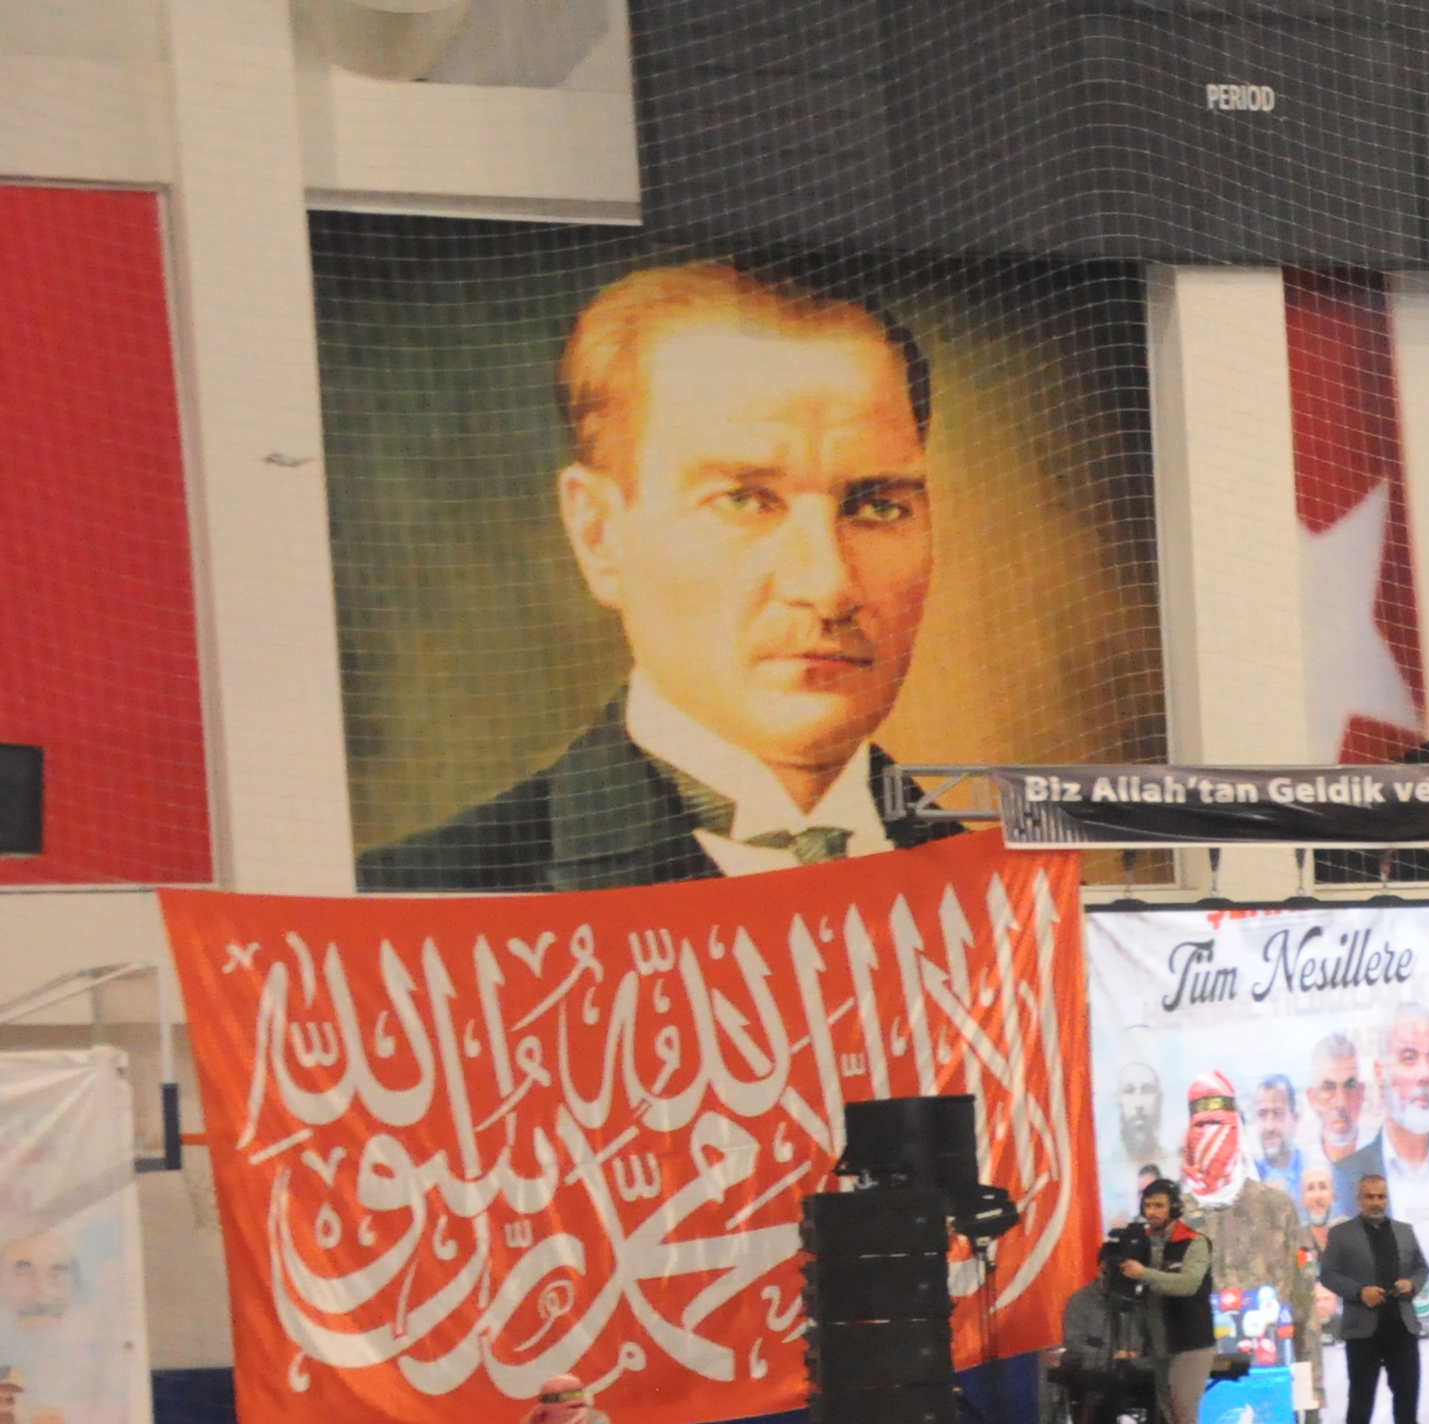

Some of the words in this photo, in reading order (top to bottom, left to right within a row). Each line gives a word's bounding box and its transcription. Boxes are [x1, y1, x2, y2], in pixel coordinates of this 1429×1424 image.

[1206, 83, 1275, 111] PERIOD
[1024, 775, 1082, 802] Biz
[1266, 775, 1385, 804] Geldik
[1162, 938, 1238, 1012] Tüm
[1251, 926, 1414, 1002] Nesillere
